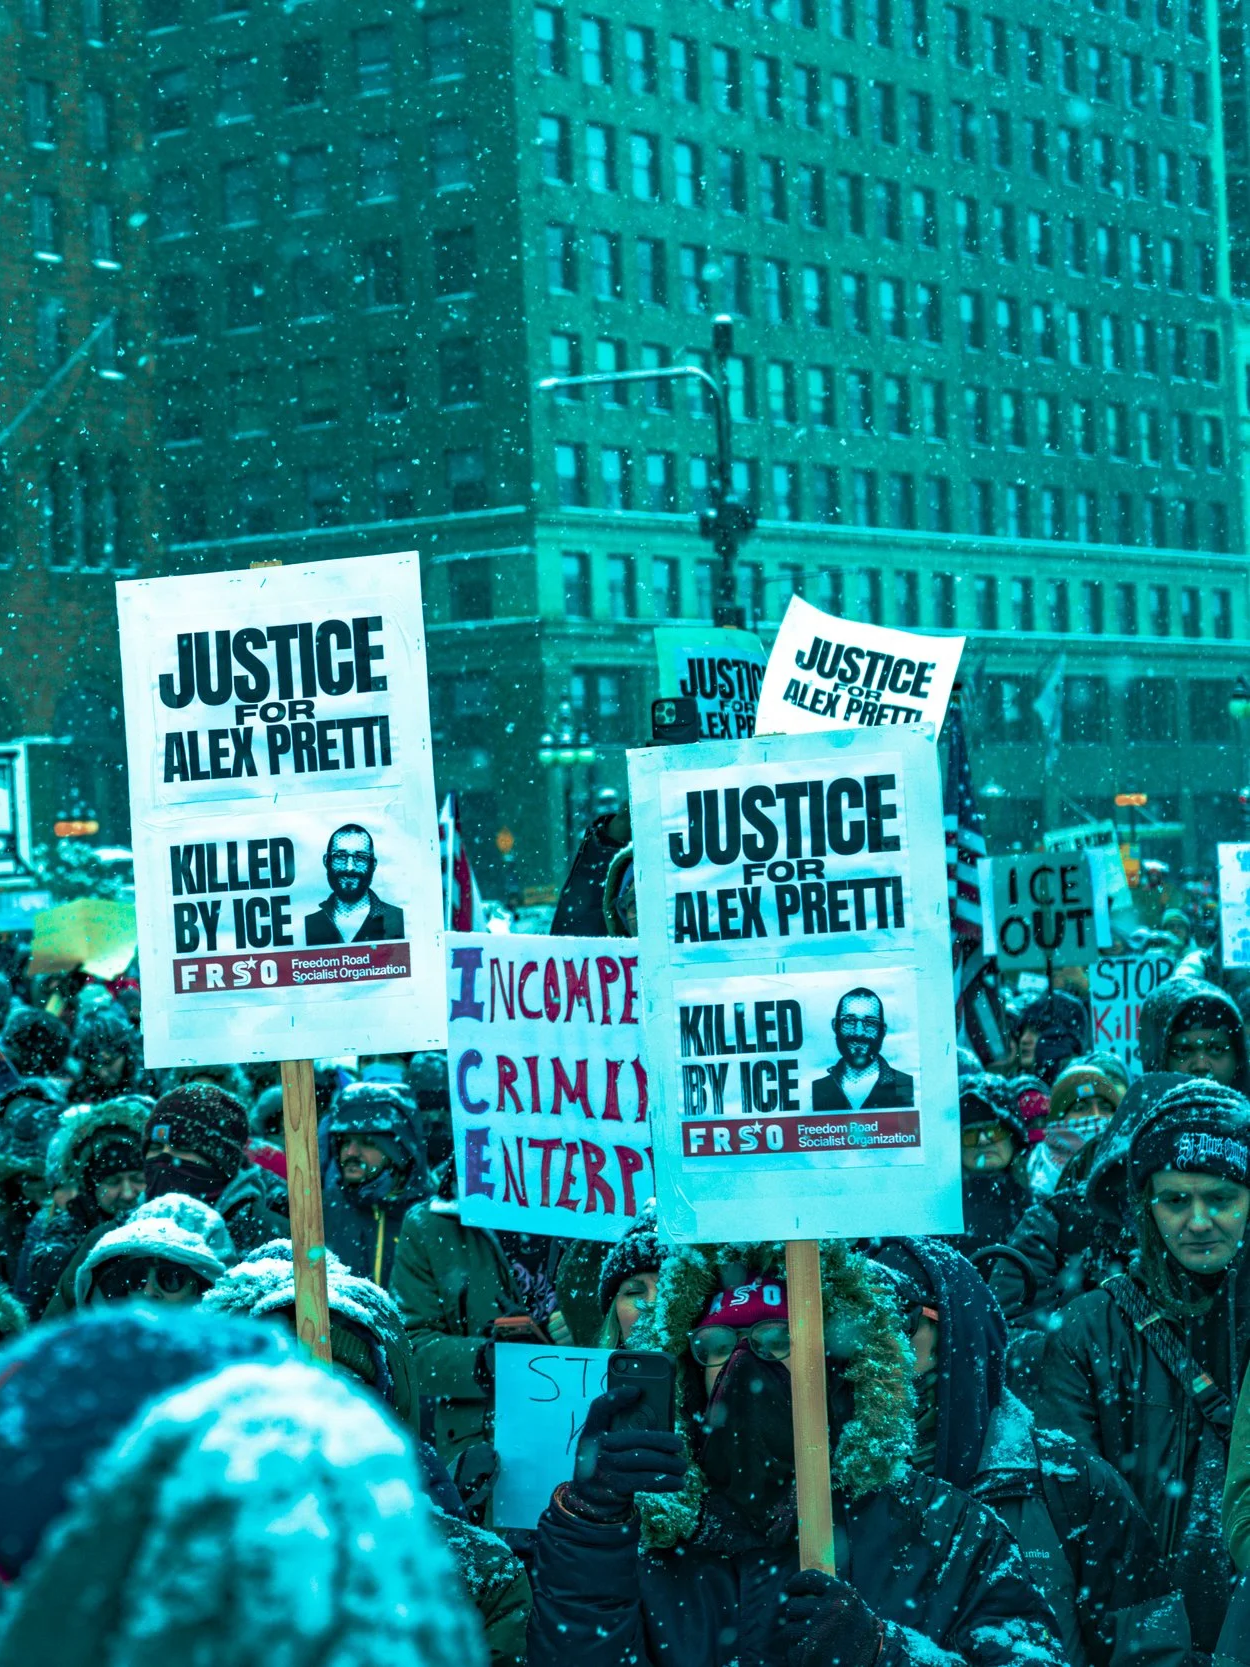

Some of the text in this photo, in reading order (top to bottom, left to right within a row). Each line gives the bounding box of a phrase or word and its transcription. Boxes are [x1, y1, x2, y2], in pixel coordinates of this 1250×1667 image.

[159, 615, 388, 710] JUSTICE
[795, 636, 936, 698] JUSTICE
[235, 699, 315, 726] FOR
[720, 700, 755, 713] FOR
[782, 678, 837, 718] ALEX
[832, 683, 882, 702] FOR
[164, 714, 392, 784] ALEX PRETTI
[668, 774, 901, 870] JUSTICE
[170, 836, 296, 897] KILLED
[743, 859, 826, 886] FOR
[1008, 864, 1080, 906] ICE
[174, 895, 295, 954] BY ICE
[675, 876, 905, 944] ALEX PRETTI
[1000, 908, 1093, 957] OUT
[180, 953, 370, 991] FRSO Freedom Road
[292, 964, 407, 982] Socialist Organization
[1092, 957, 1174, 1001] STOP
[680, 998, 803, 1059] KILLED
[683, 1058, 801, 1117] BY ICE
[689, 1120, 879, 1154] FRSO Freedom Road
[798, 1132, 916, 1148] Socialist Organization
[465, 1127, 656, 1217] ENTERP
[528, 1355, 609, 1403] ST
